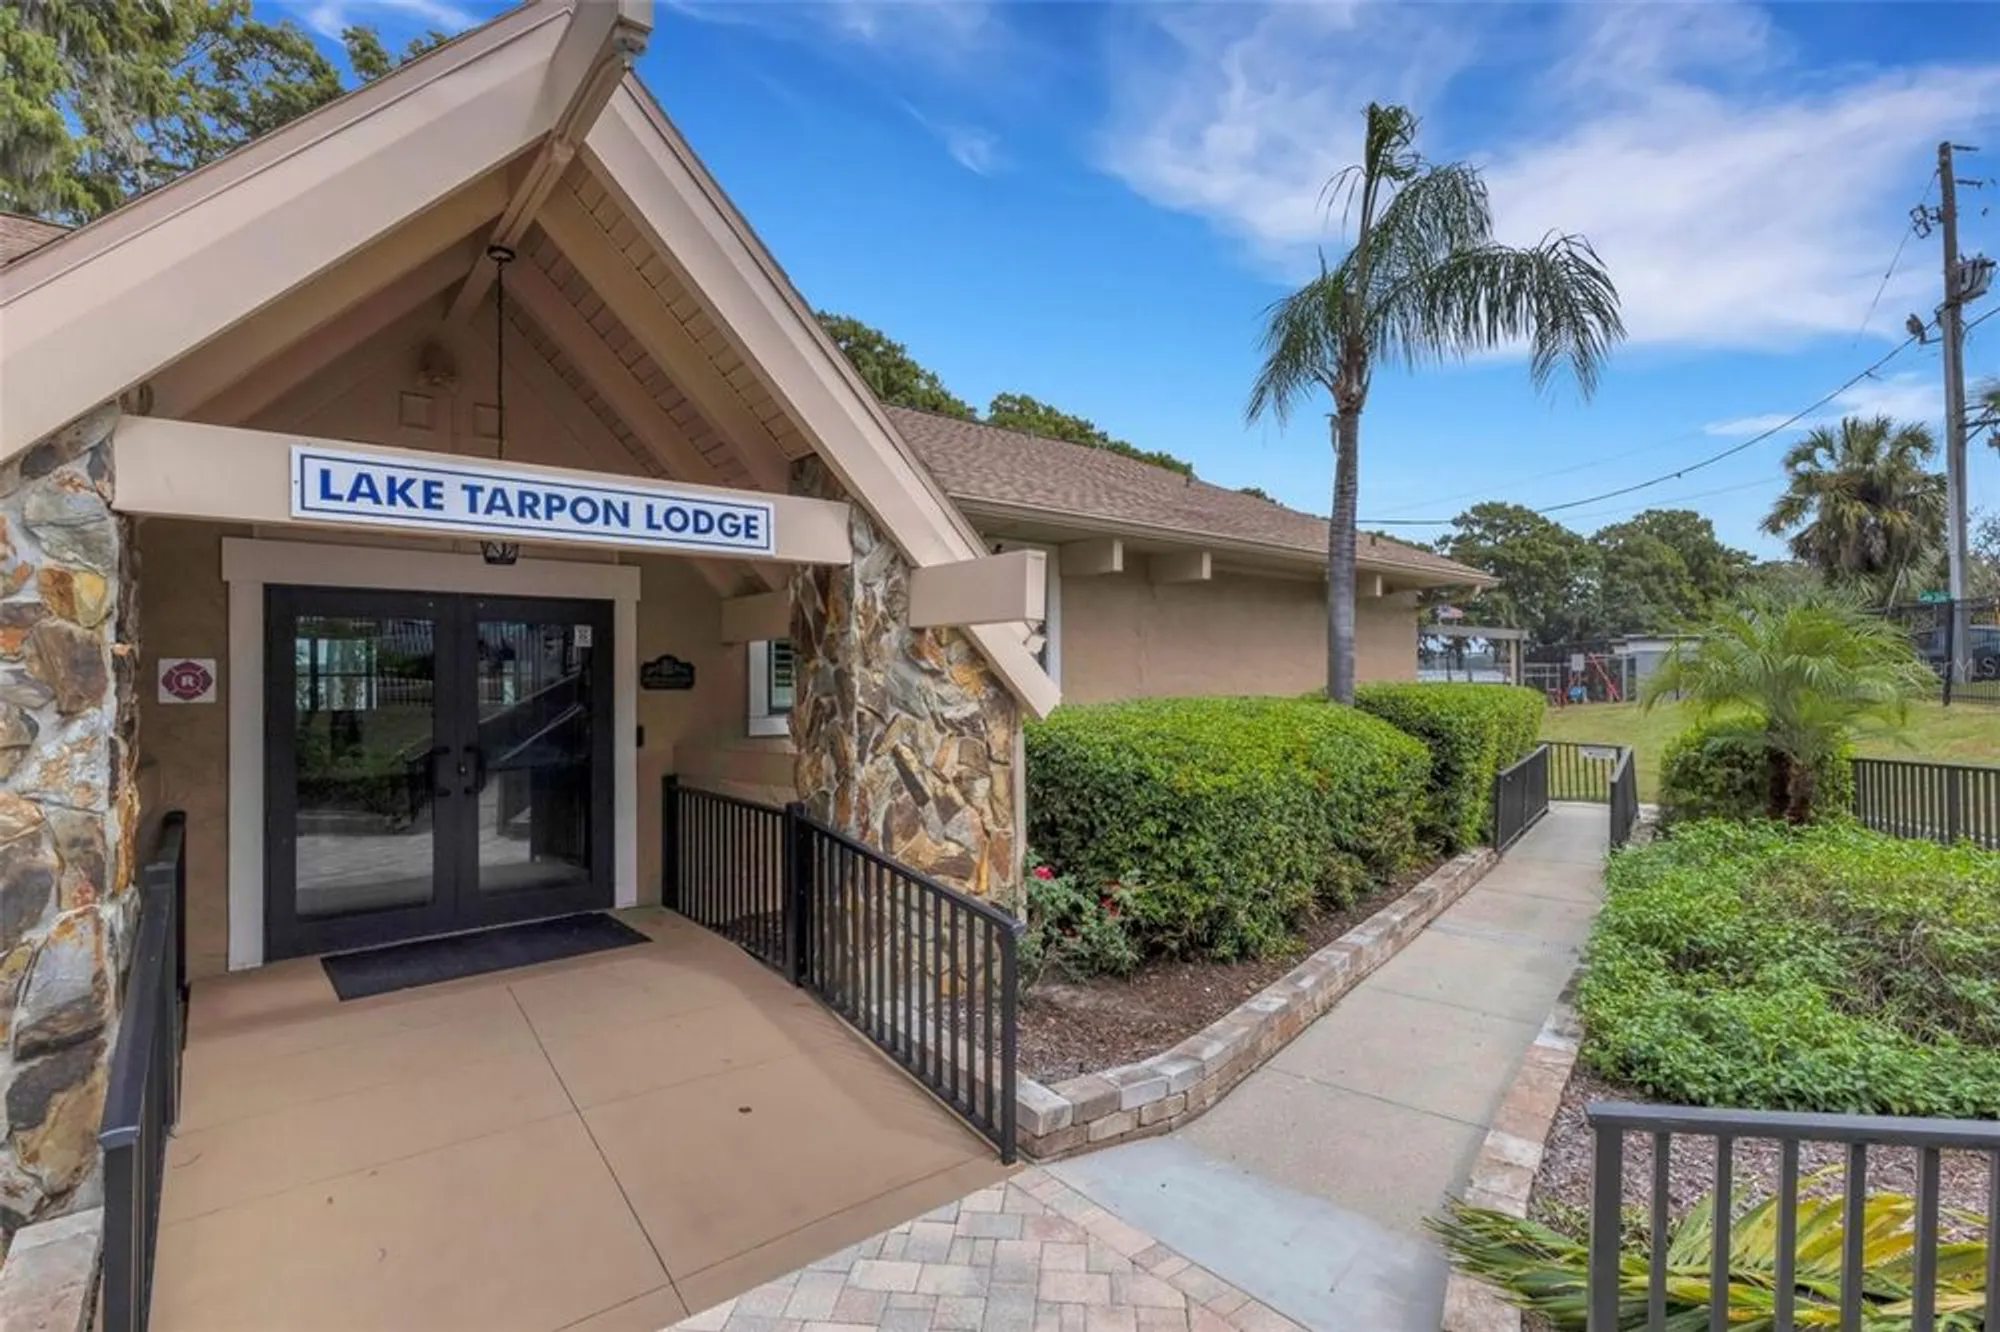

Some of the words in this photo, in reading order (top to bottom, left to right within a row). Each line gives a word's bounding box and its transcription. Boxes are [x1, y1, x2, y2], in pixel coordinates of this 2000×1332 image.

[320, 468, 444, 511] LAKE
[461, 483, 631, 528] TARPON
[645, 503, 759, 539] LODGE
